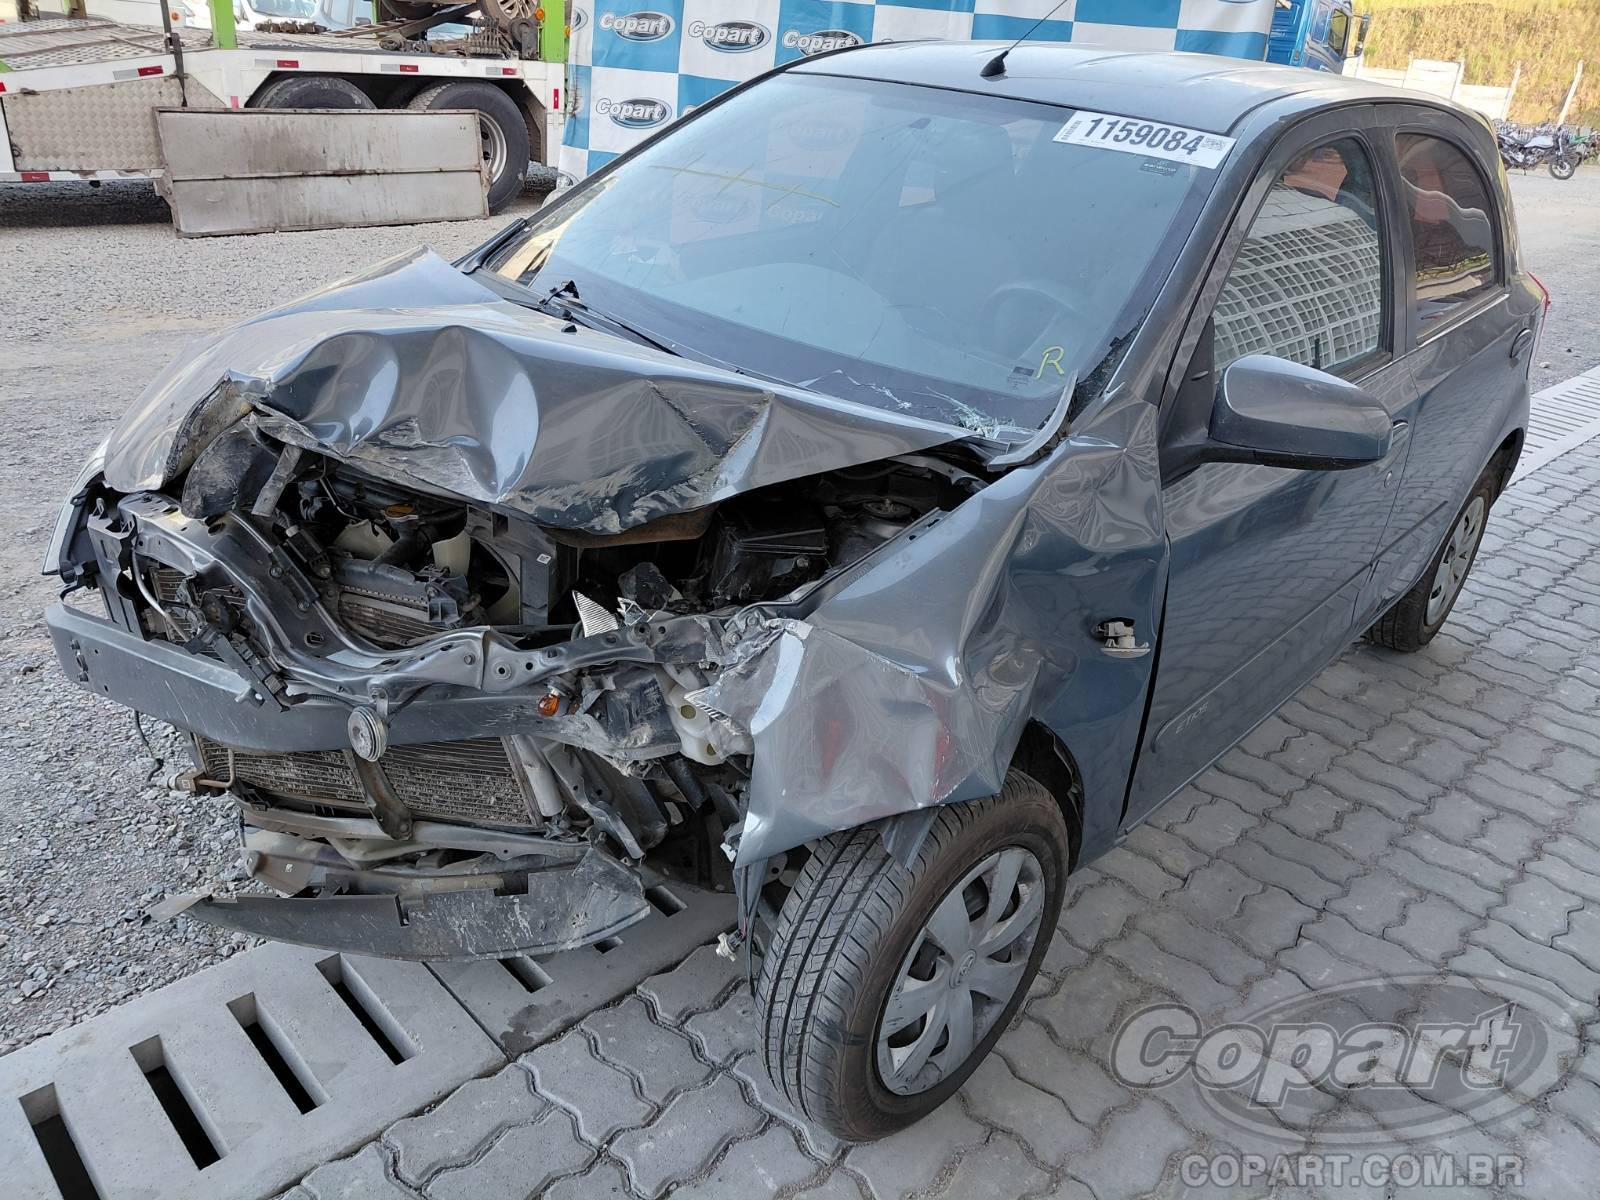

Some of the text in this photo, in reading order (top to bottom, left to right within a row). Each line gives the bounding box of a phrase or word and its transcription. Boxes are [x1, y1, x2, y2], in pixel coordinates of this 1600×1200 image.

[600, 12, 667, 35] Copart
[690, 21, 761, 46] Copart
[597, 99, 663, 121] Copart
[1085, 118, 1207, 155] 1159084
[1036, 346, 1065, 380] R
